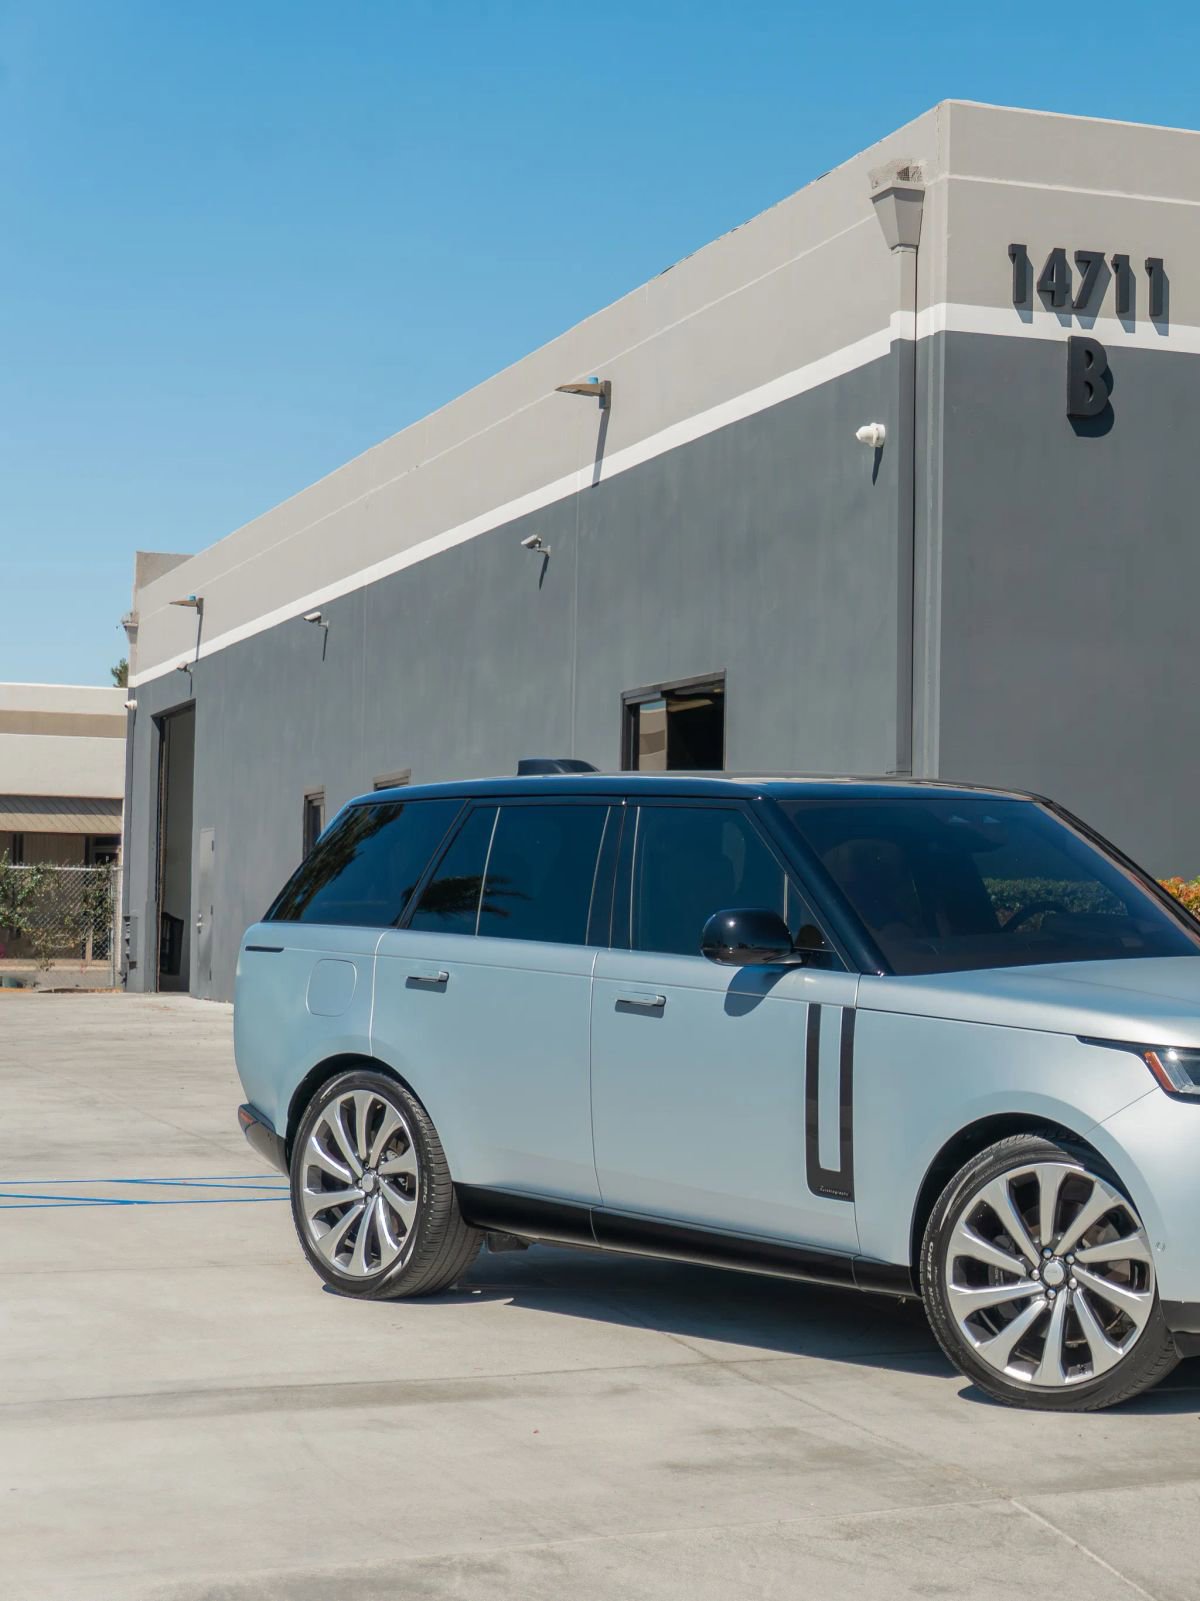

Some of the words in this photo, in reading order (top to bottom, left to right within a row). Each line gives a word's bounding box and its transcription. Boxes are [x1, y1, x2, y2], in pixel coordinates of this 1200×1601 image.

[1008, 244, 1164, 316] 14711
[1066, 336, 1107, 417] B
[926, 1241, 934, 1281] ZERO
